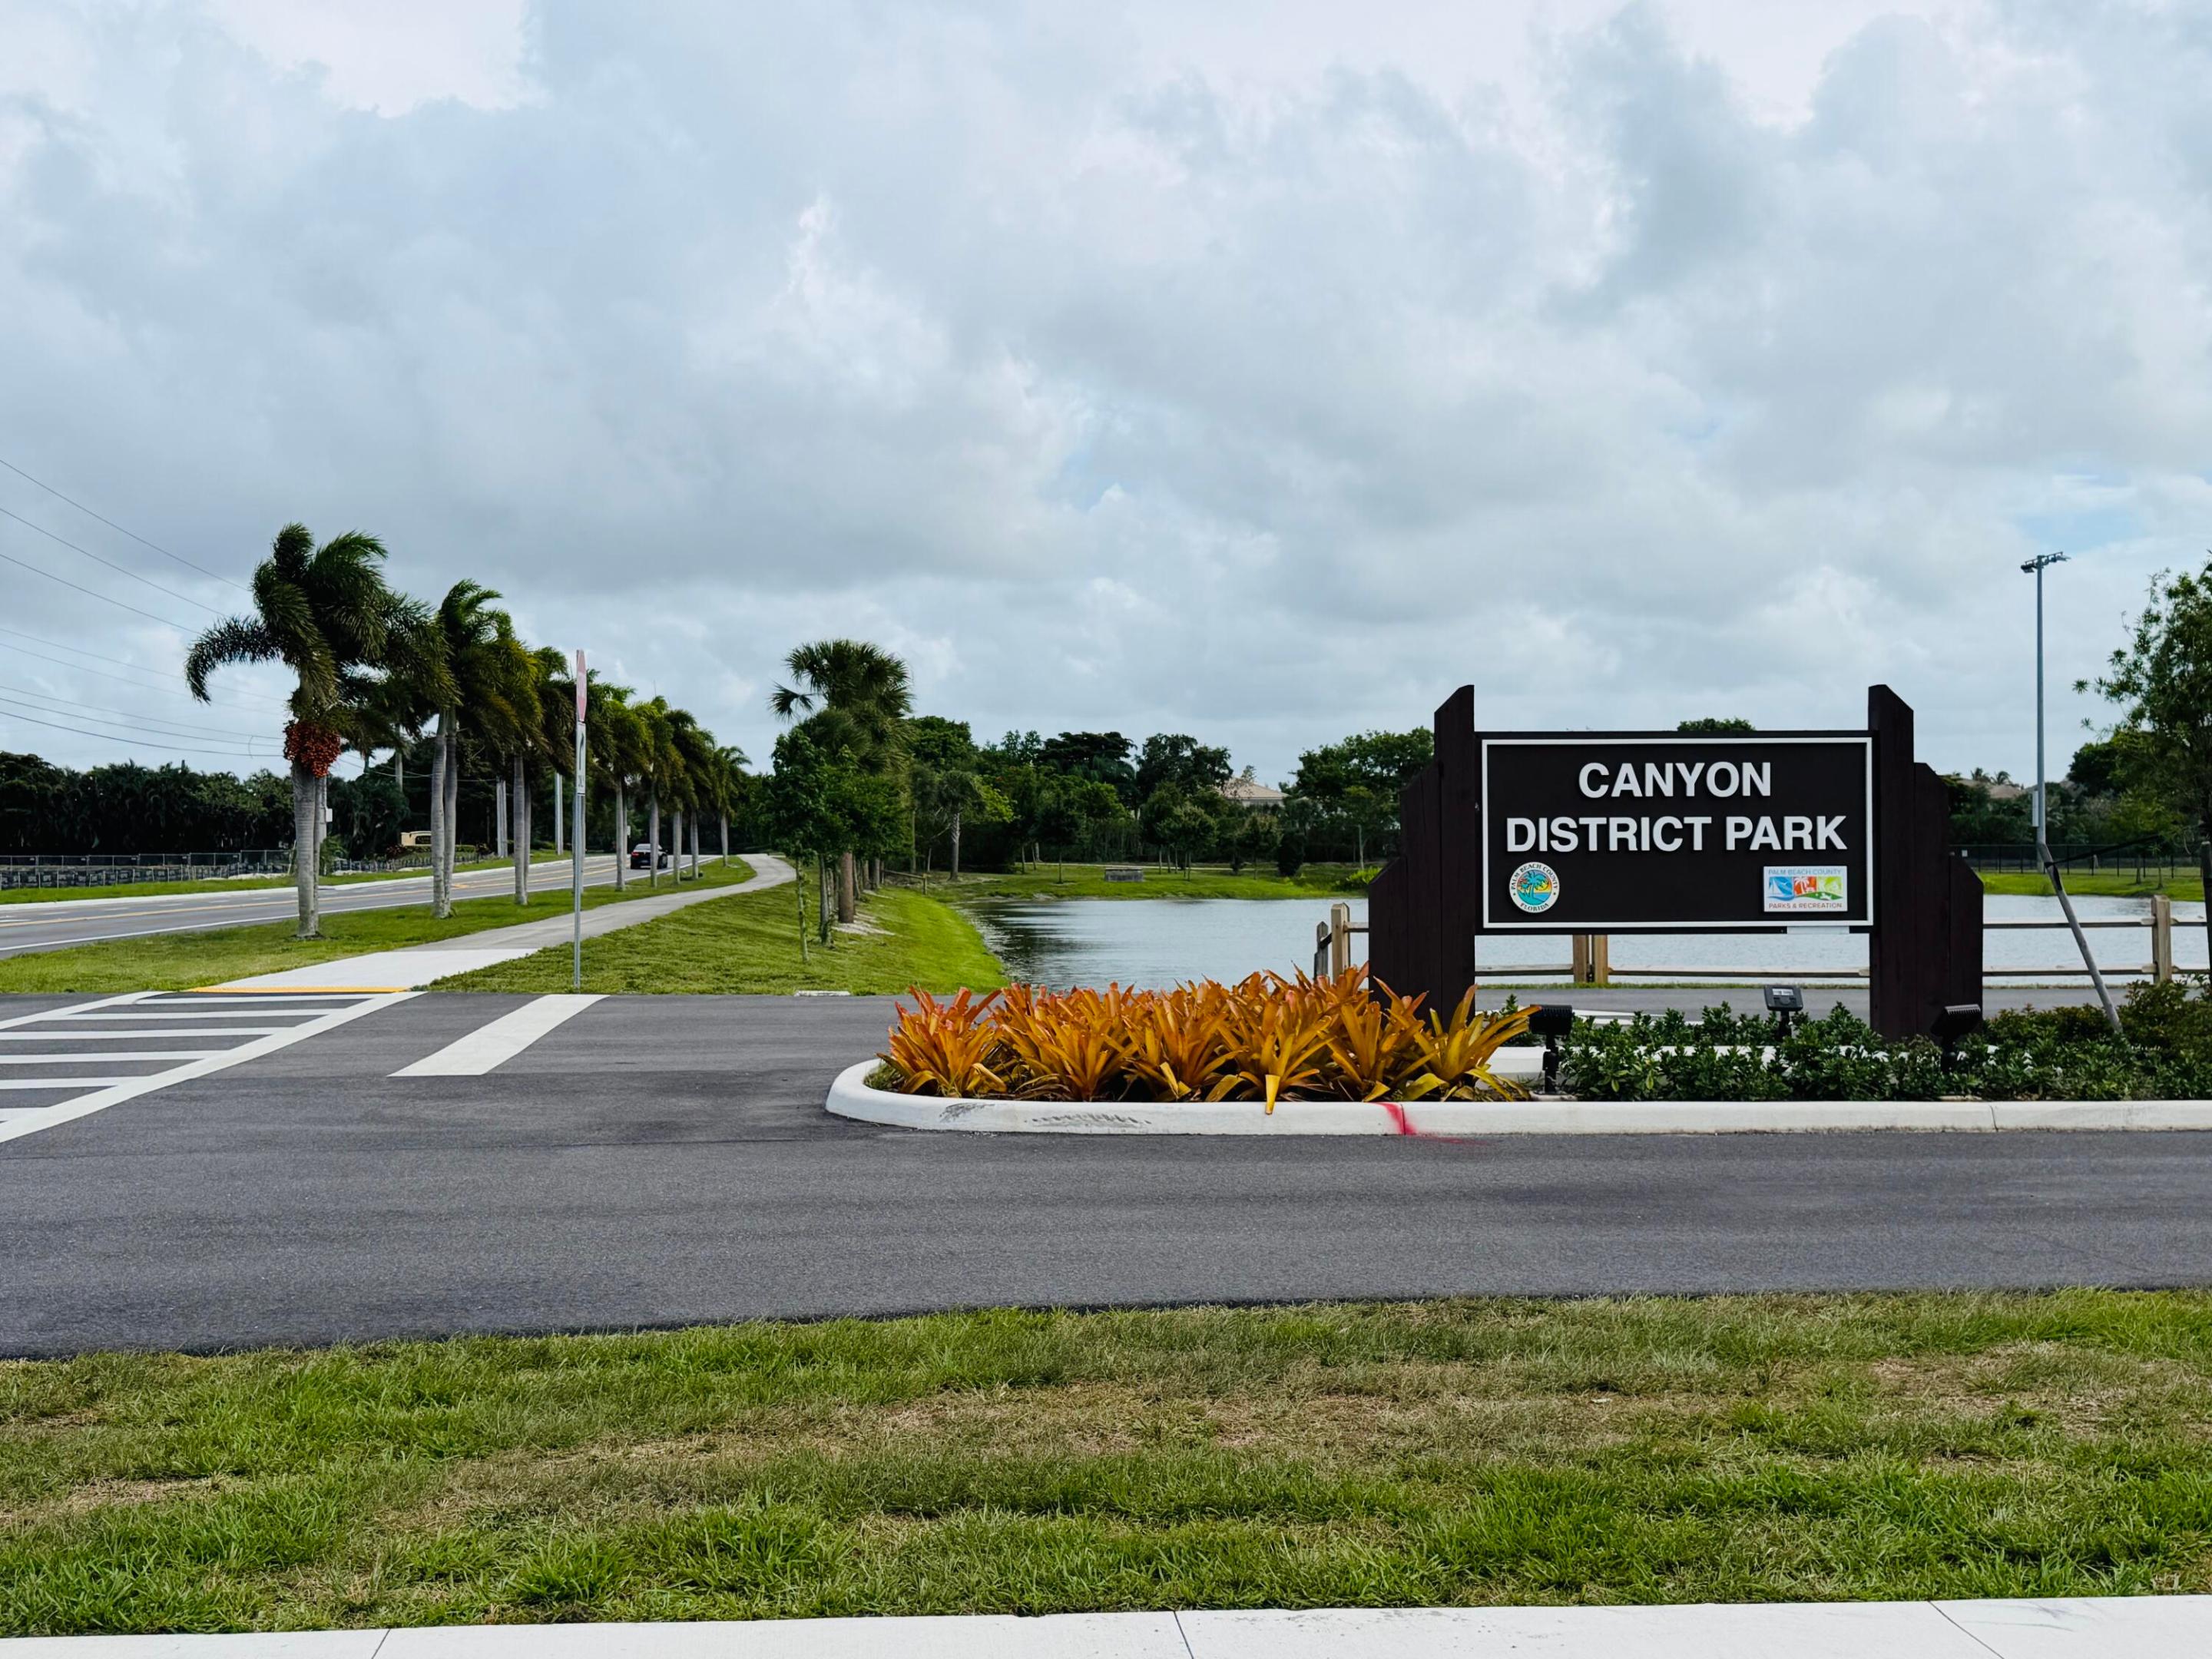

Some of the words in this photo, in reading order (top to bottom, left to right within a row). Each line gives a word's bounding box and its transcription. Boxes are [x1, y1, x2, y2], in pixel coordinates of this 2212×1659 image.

[1579, 761, 1771, 798] CANYON
[1507, 816, 1712, 853] DISTRICT
[1726, 816, 1847, 850] PARK
[1511, 873, 1520, 890] PALM
[1520, 863, 1541, 873] BEACH
[1542, 866, 1558, 889] COUNTY
[1521, 902, 1549, 912] FLORIDA
